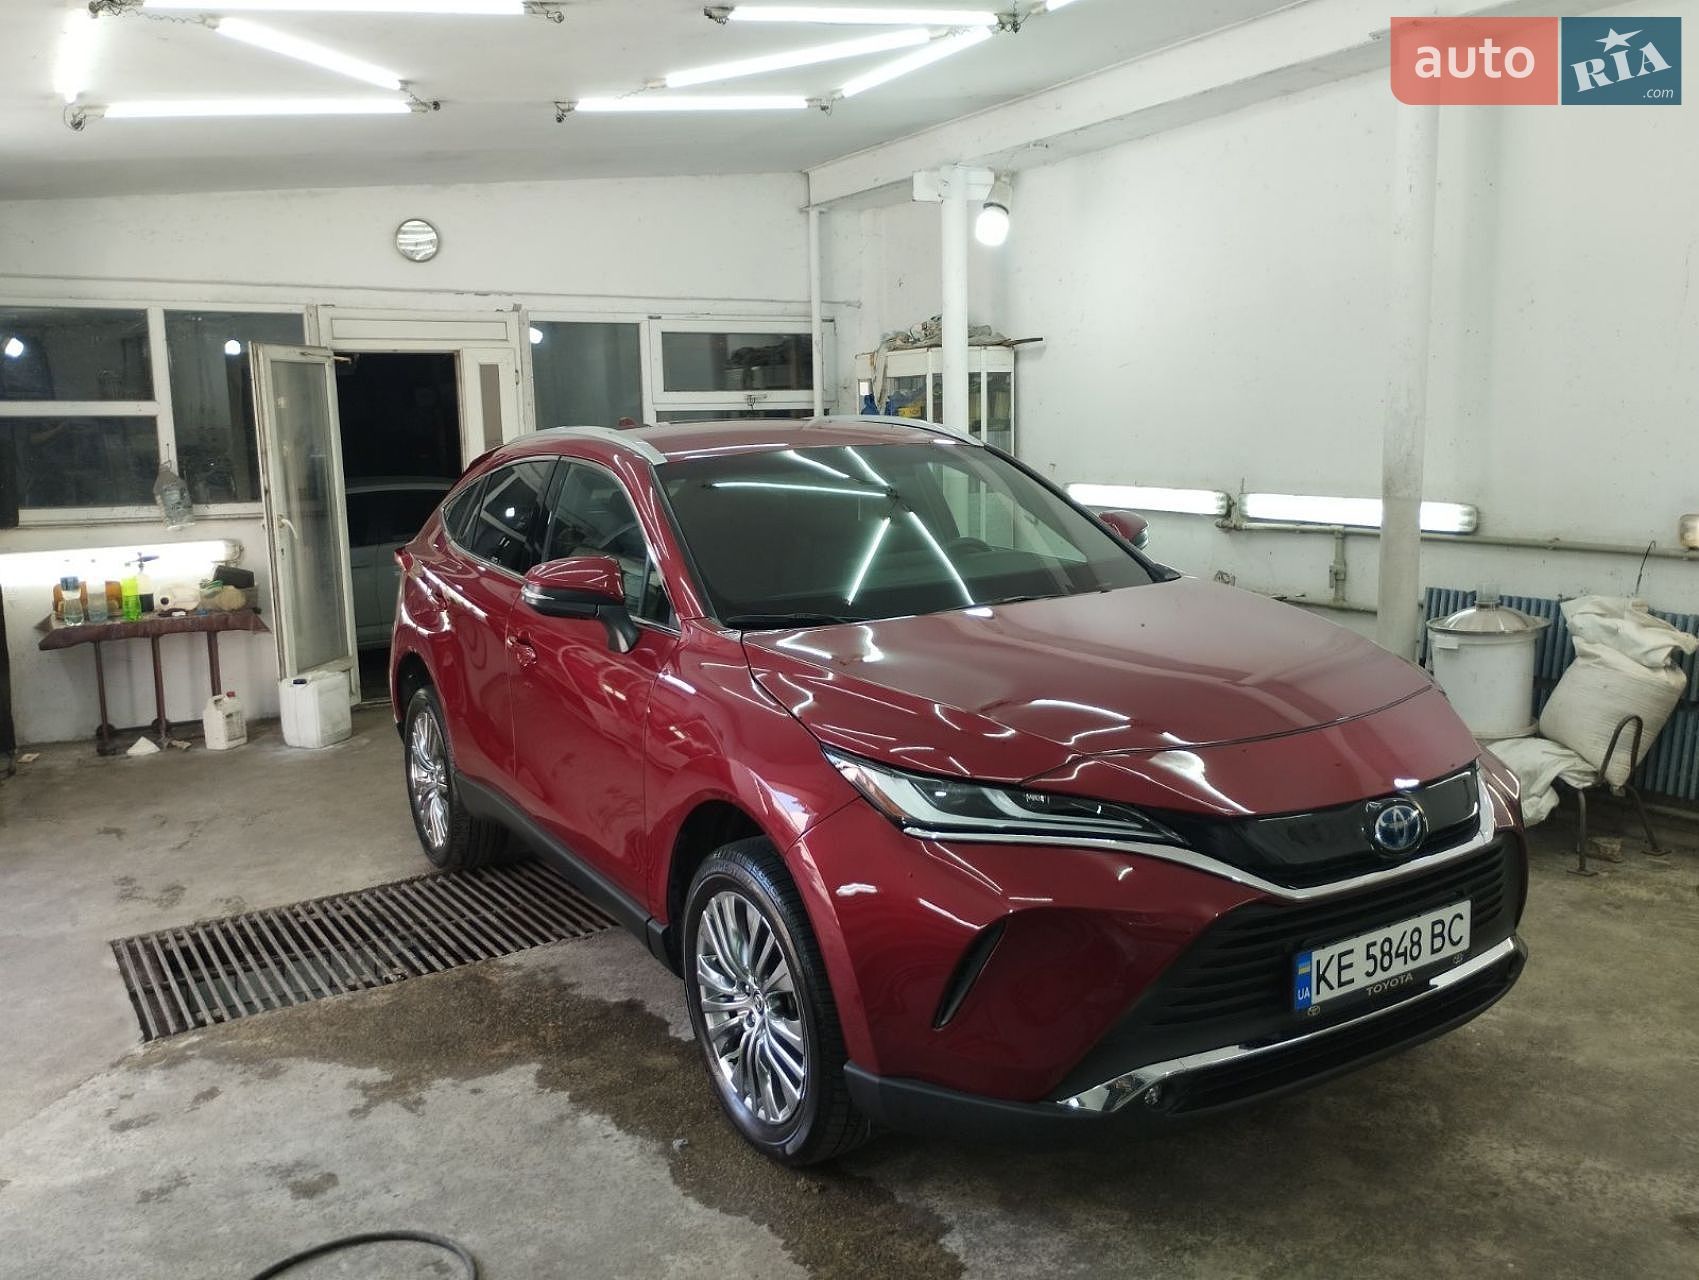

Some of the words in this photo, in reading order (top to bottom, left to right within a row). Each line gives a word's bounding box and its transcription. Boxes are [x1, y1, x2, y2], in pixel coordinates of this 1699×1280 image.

[1316, 949, 1355, 996] KE
[1365, 926, 1423, 978] 5848
[1430, 913, 1464, 956] BC
[1298, 988, 1310, 1000] UA
[1366, 972, 1414, 997] TOYOTA
